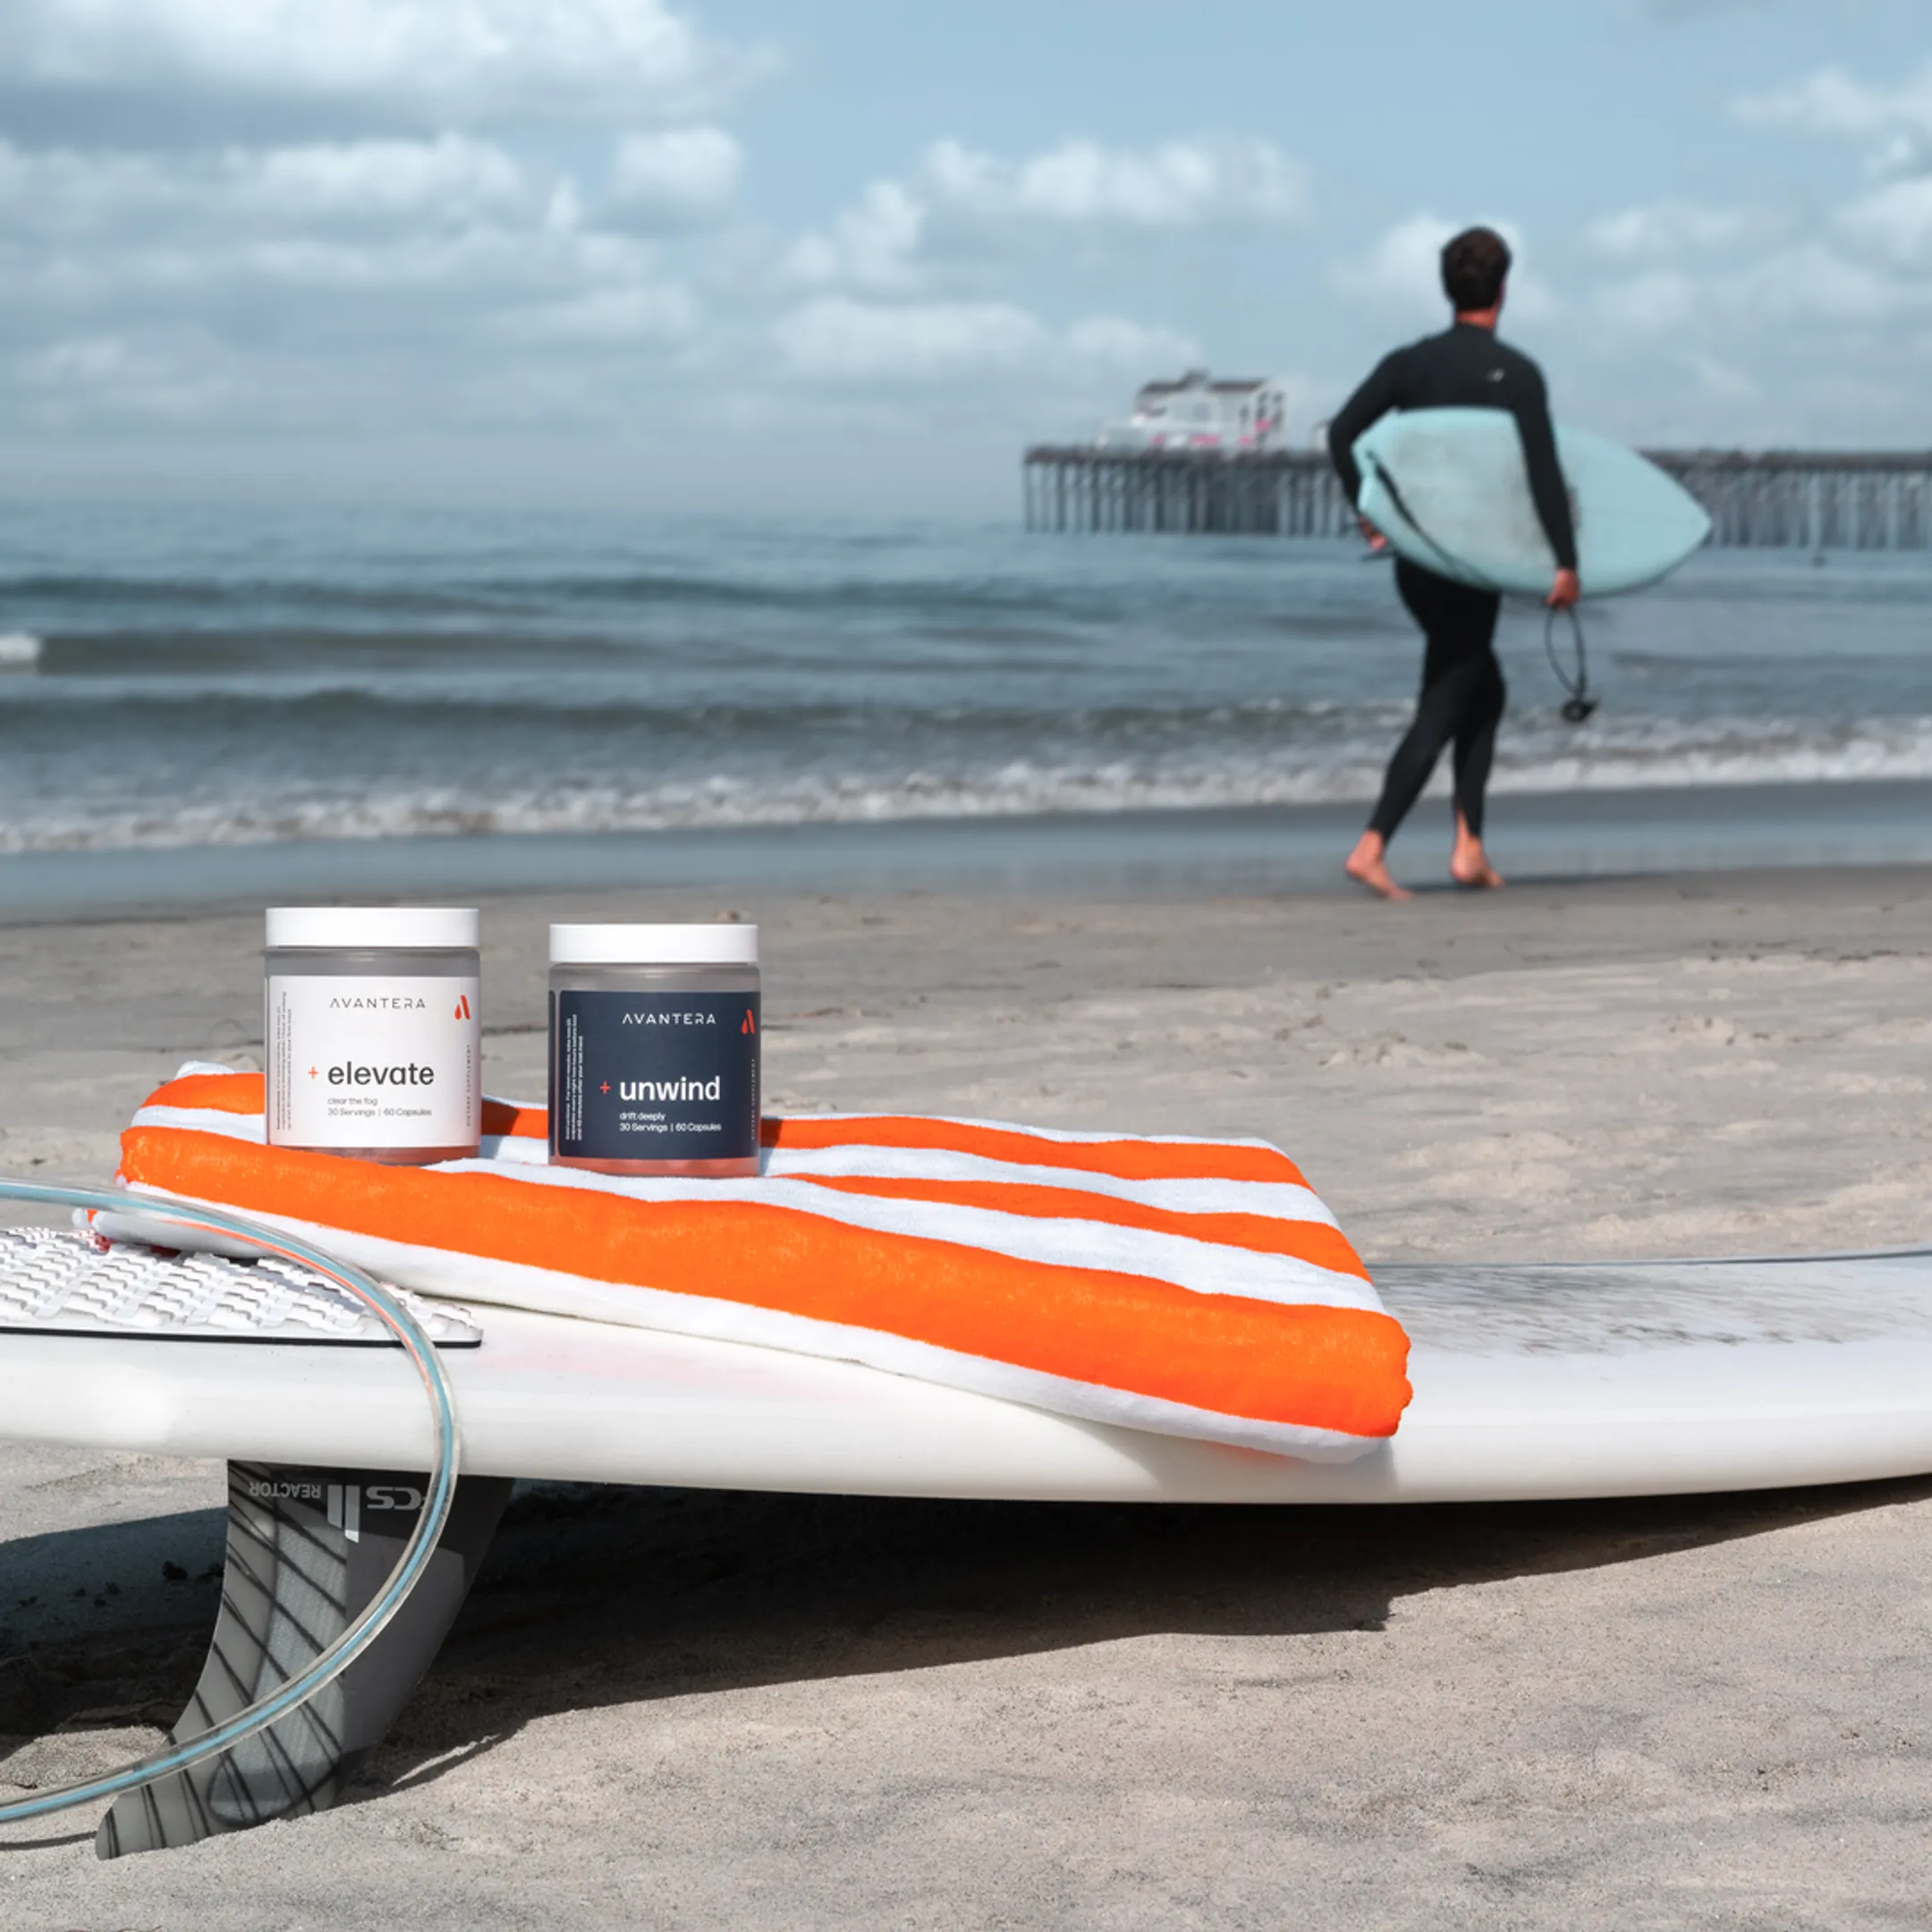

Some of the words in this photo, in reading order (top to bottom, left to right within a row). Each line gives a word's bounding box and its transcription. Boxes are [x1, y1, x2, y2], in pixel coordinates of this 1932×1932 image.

[329, 997, 426, 1009] AVANTERA
[622, 1013, 716, 1025] AVANTERA
[327, 1061, 435, 1085] elevate
[620, 1075, 721, 1101] unwind
[327, 1097, 347, 1106] clear
[349, 1097, 362, 1106] the
[363, 1097, 378, 1106] fog
[327, 1108, 338, 1116] 30
[339, 1108, 376, 1117] Servings
[383, 1108, 394, 1116] 60
[396, 1108, 432, 1117] Capsules
[619, 1112, 637, 1121] drift
[638, 1112, 666, 1122] deeply
[619, 1123, 631, 1131] 30
[631, 1123, 668, 1133] Servings
[675, 1123, 686, 1131] 60
[687, 1123, 722, 1132] Capsules
[249, 1481, 321, 1499] REACTOR
[366, 1486, 425, 1511] CS
